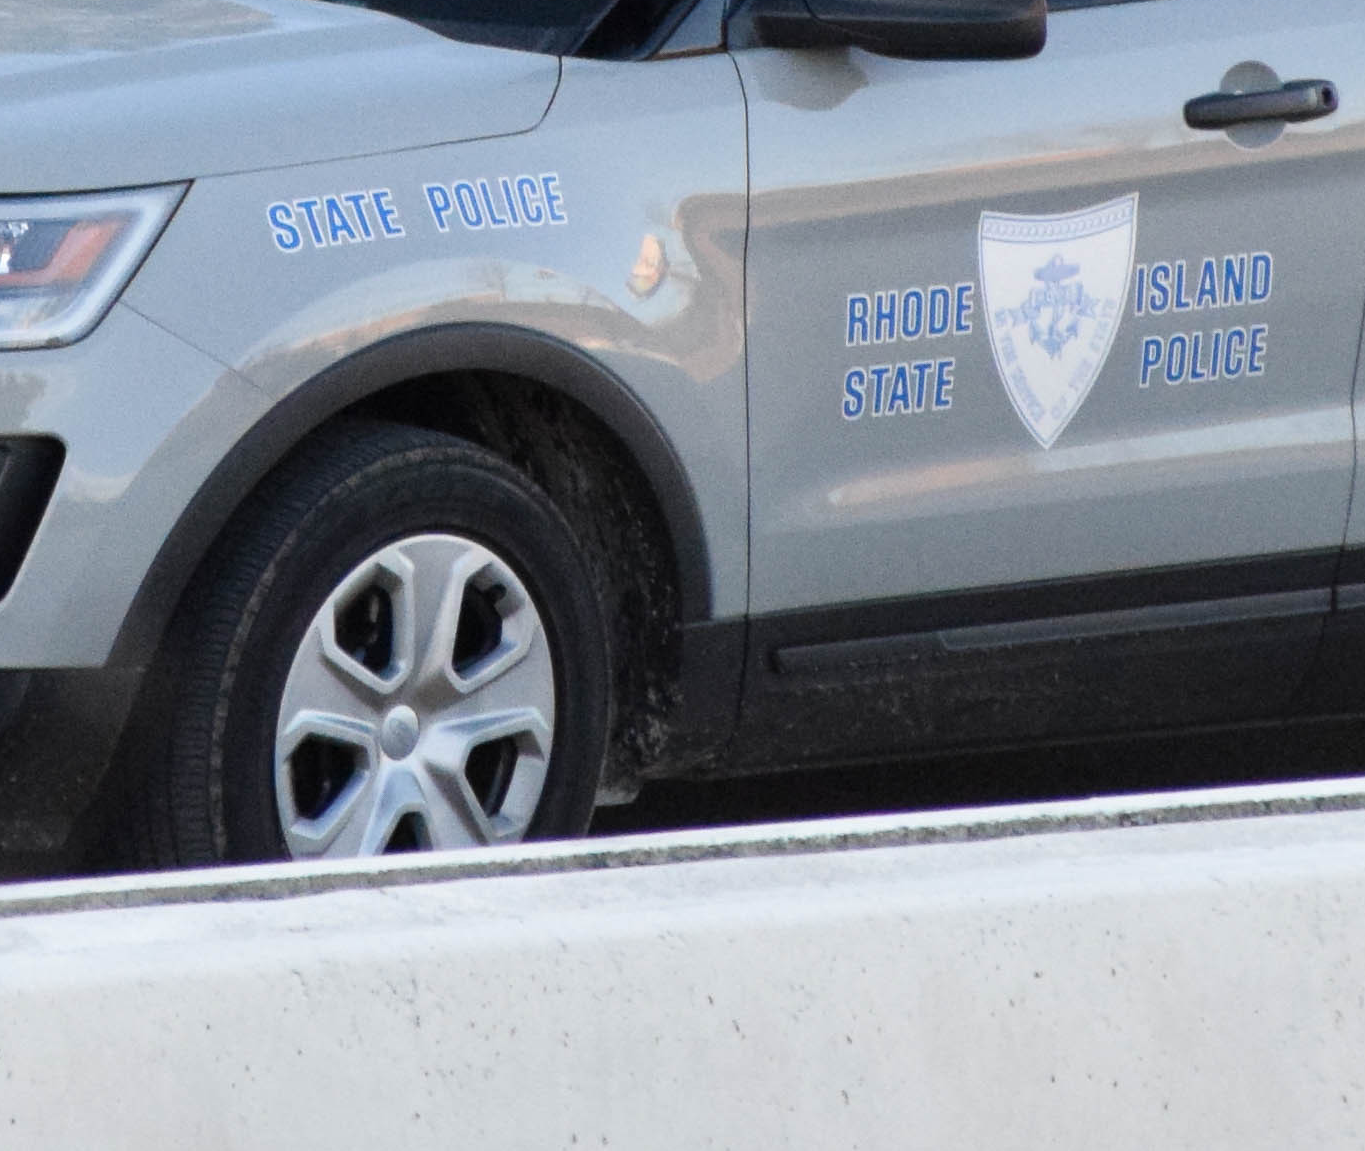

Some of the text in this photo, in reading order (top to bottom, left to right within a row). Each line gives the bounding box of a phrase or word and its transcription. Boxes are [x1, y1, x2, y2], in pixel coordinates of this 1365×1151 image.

[266, 172, 568, 253] STATE POLICE
[846, 281, 974, 347] RHODE
[1135, 251, 1273, 317] ISLAND
[842, 357, 956, 421] STATE
[1139, 324, 1268, 388] POLICE
